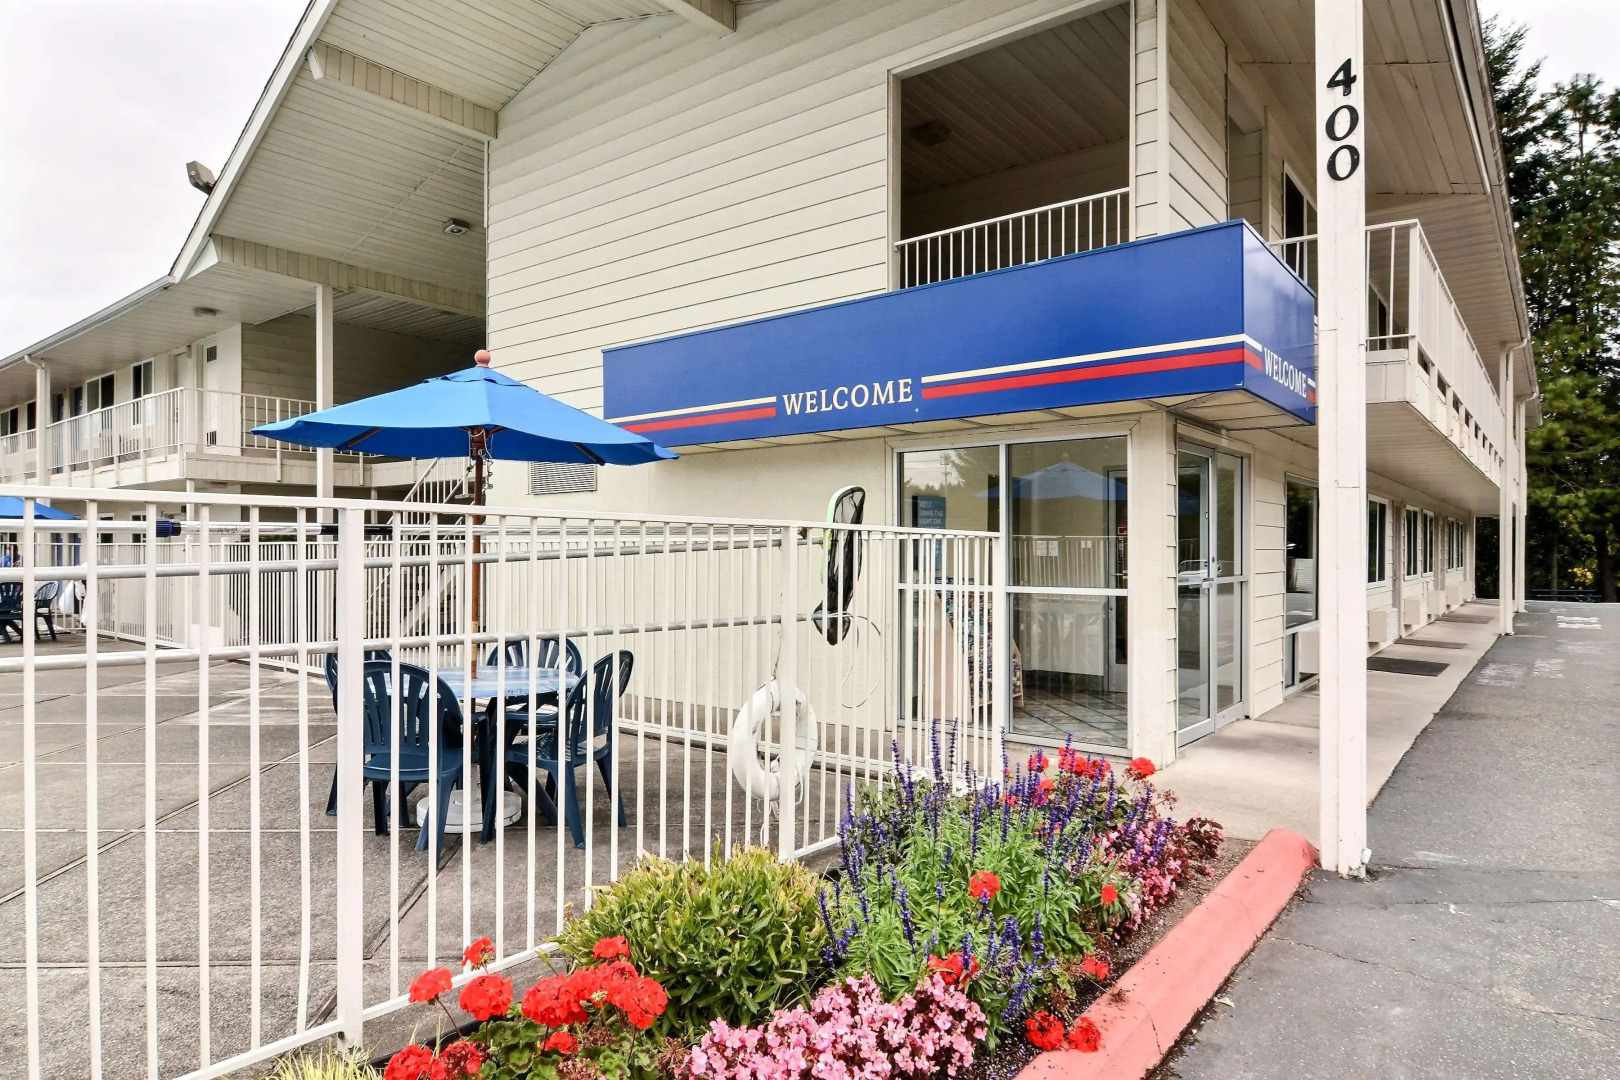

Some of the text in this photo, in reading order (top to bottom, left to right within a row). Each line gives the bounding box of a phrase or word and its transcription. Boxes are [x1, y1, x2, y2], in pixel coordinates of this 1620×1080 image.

[1325, 57, 1360, 182] 400
[782, 378, 913, 416] WELCOME
[1263, 347, 1308, 399] WELCOME
